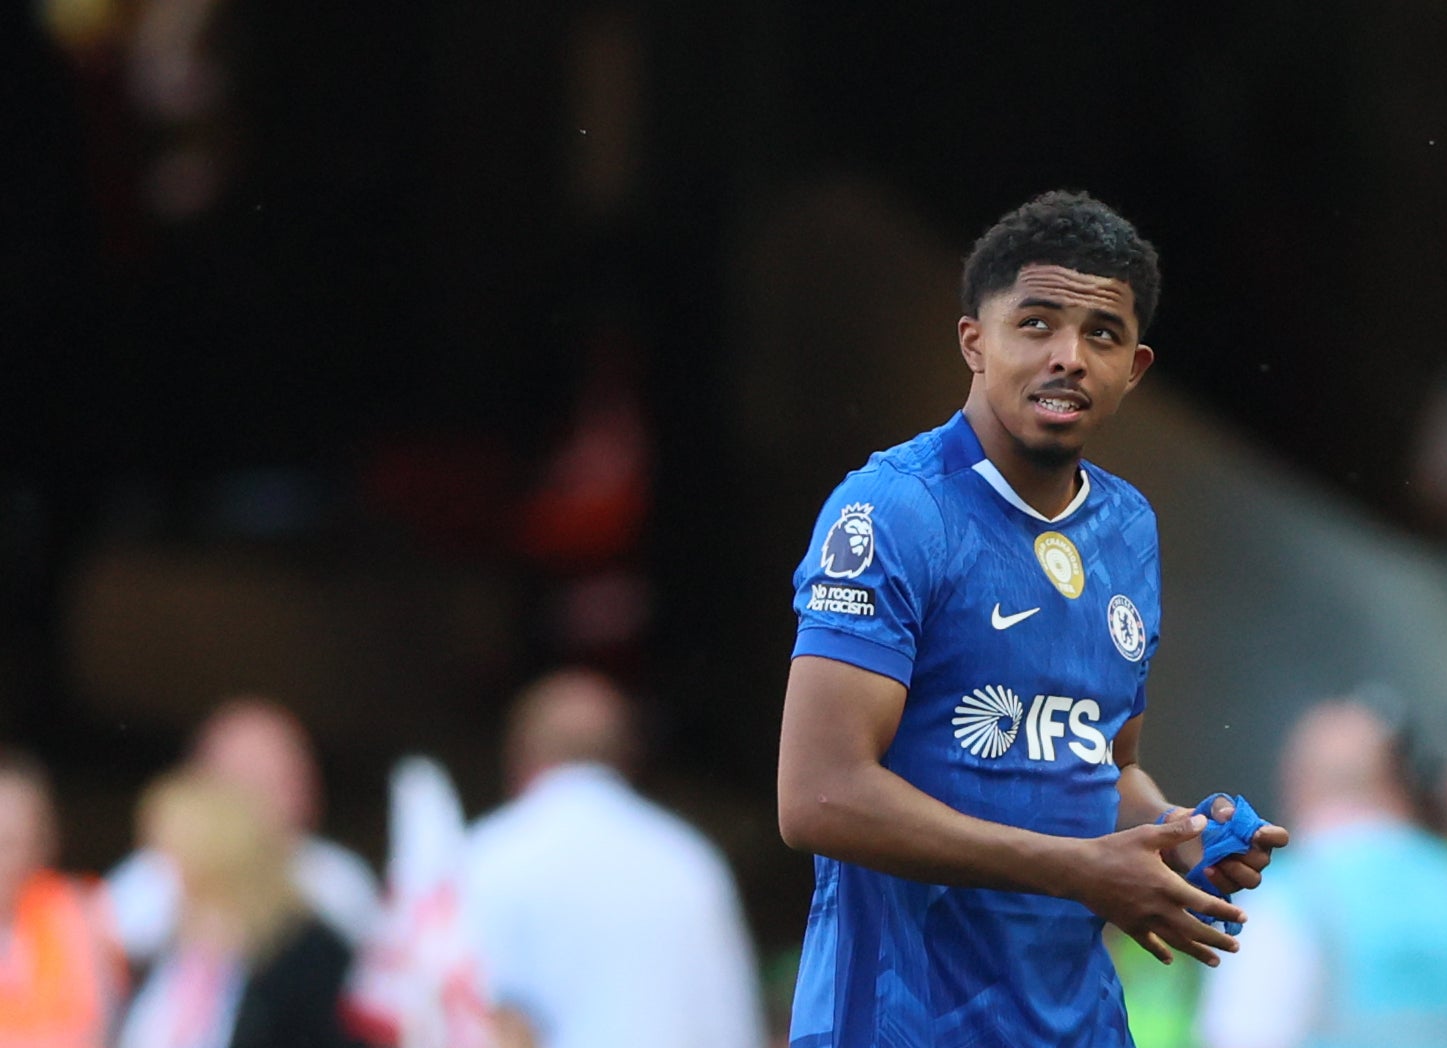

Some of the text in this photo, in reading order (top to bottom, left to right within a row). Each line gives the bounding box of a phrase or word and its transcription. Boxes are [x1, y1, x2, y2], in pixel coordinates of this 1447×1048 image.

[812, 584, 868, 603] No room
[825, 600, 875, 616] racism
